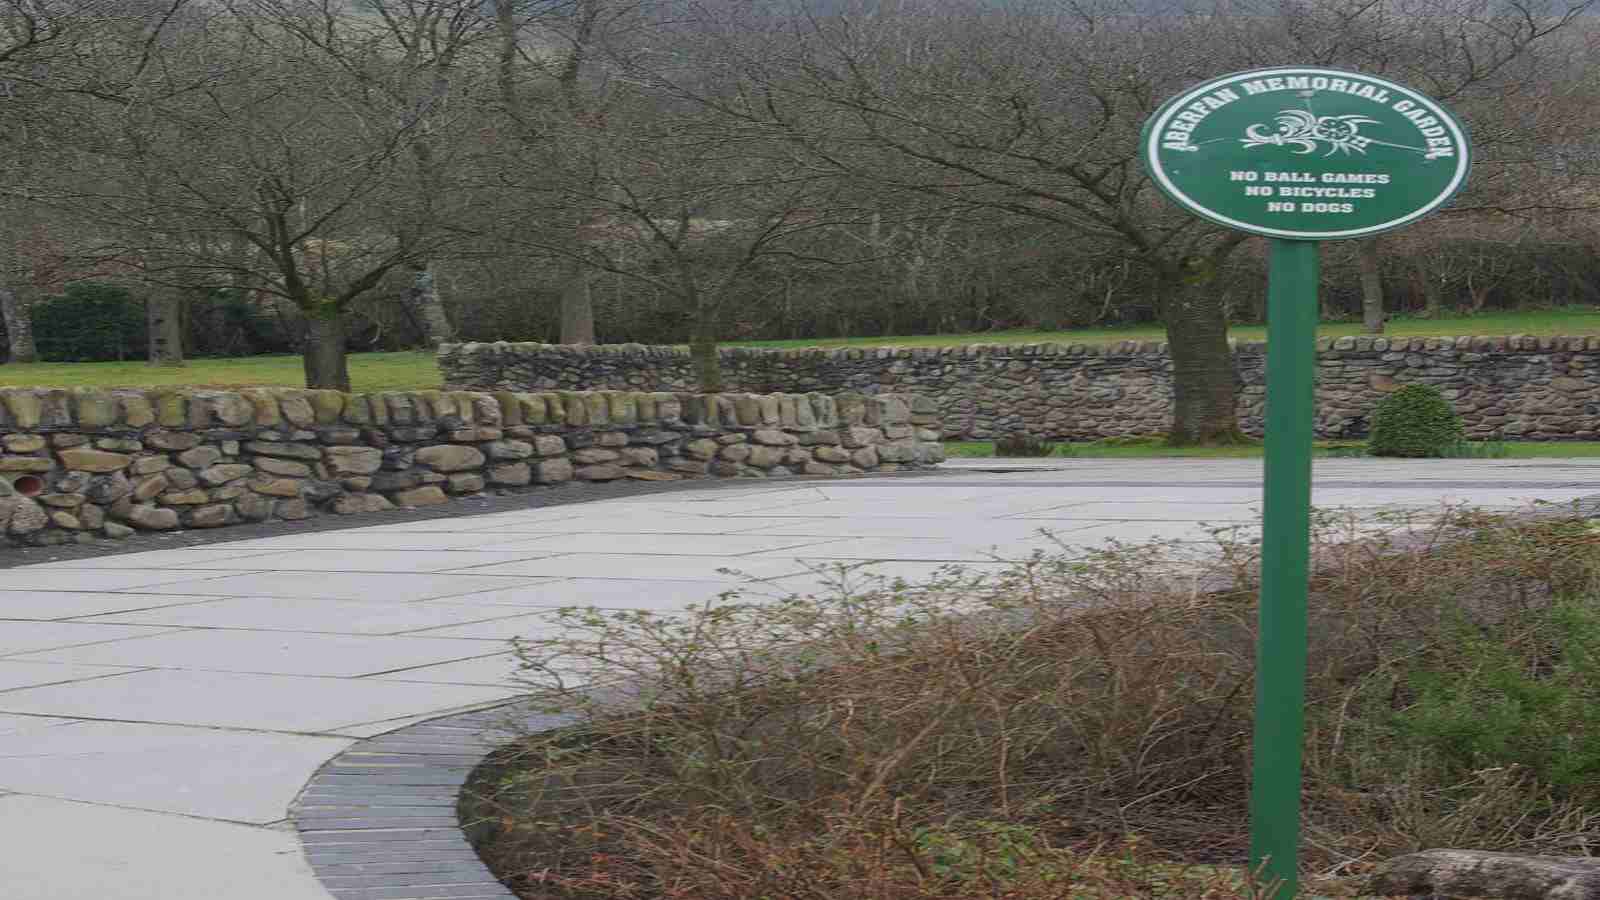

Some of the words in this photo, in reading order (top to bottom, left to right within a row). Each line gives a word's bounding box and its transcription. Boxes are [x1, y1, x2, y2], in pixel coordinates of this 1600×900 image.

[1162, 88, 1240, 153] ABERFAN
[1238, 76, 1392, 105] MEMORIAL
[1391, 99, 1455, 161] GARDEN
[1230, 170, 1258, 182] NO
[1264, 170, 1315, 183] BALL
[1321, 172, 1391, 184] GAMES
[1245, 185, 1273, 197] NO
[1279, 186, 1376, 199] BICYCLES
[1267, 201, 1296, 213] NO
[1301, 201, 1353, 214] DOGS
